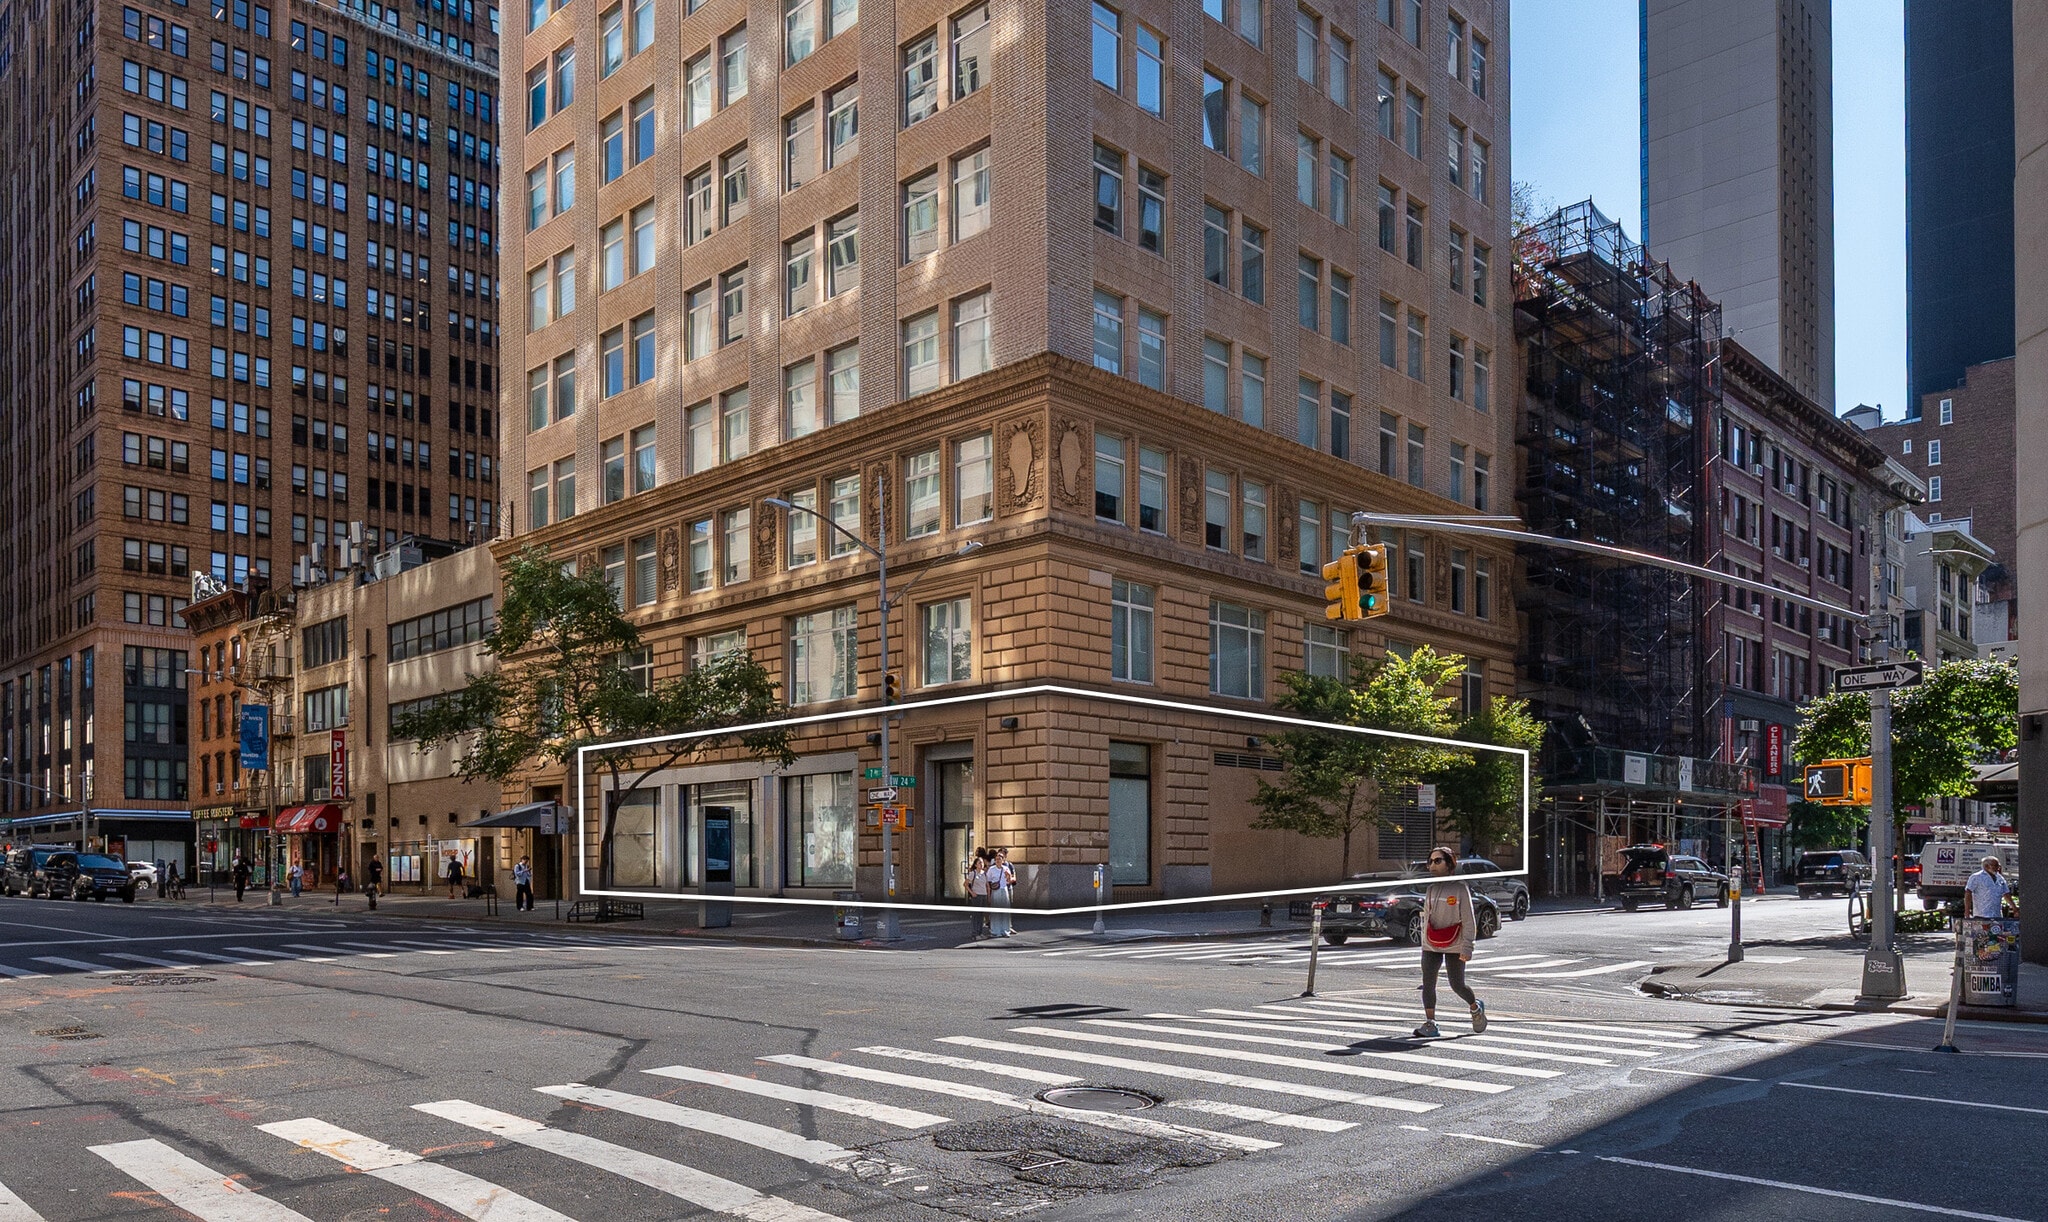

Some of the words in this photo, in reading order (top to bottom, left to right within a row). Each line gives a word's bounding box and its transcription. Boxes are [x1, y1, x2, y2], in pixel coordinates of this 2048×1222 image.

[1844, 674, 1867, 685] ONE
[1882, 669, 1907, 682] WAY
[1770, 726, 1779, 774] CLEANERS
[333, 740, 344, 797] PIZZA
[900, 777, 909, 786] 24
[193, 808, 210, 819] COFFEE
[210, 806, 234, 818] ROASTERS
[1939, 849, 1954, 859] RR
[1971, 976, 2001, 992] GUMBA
